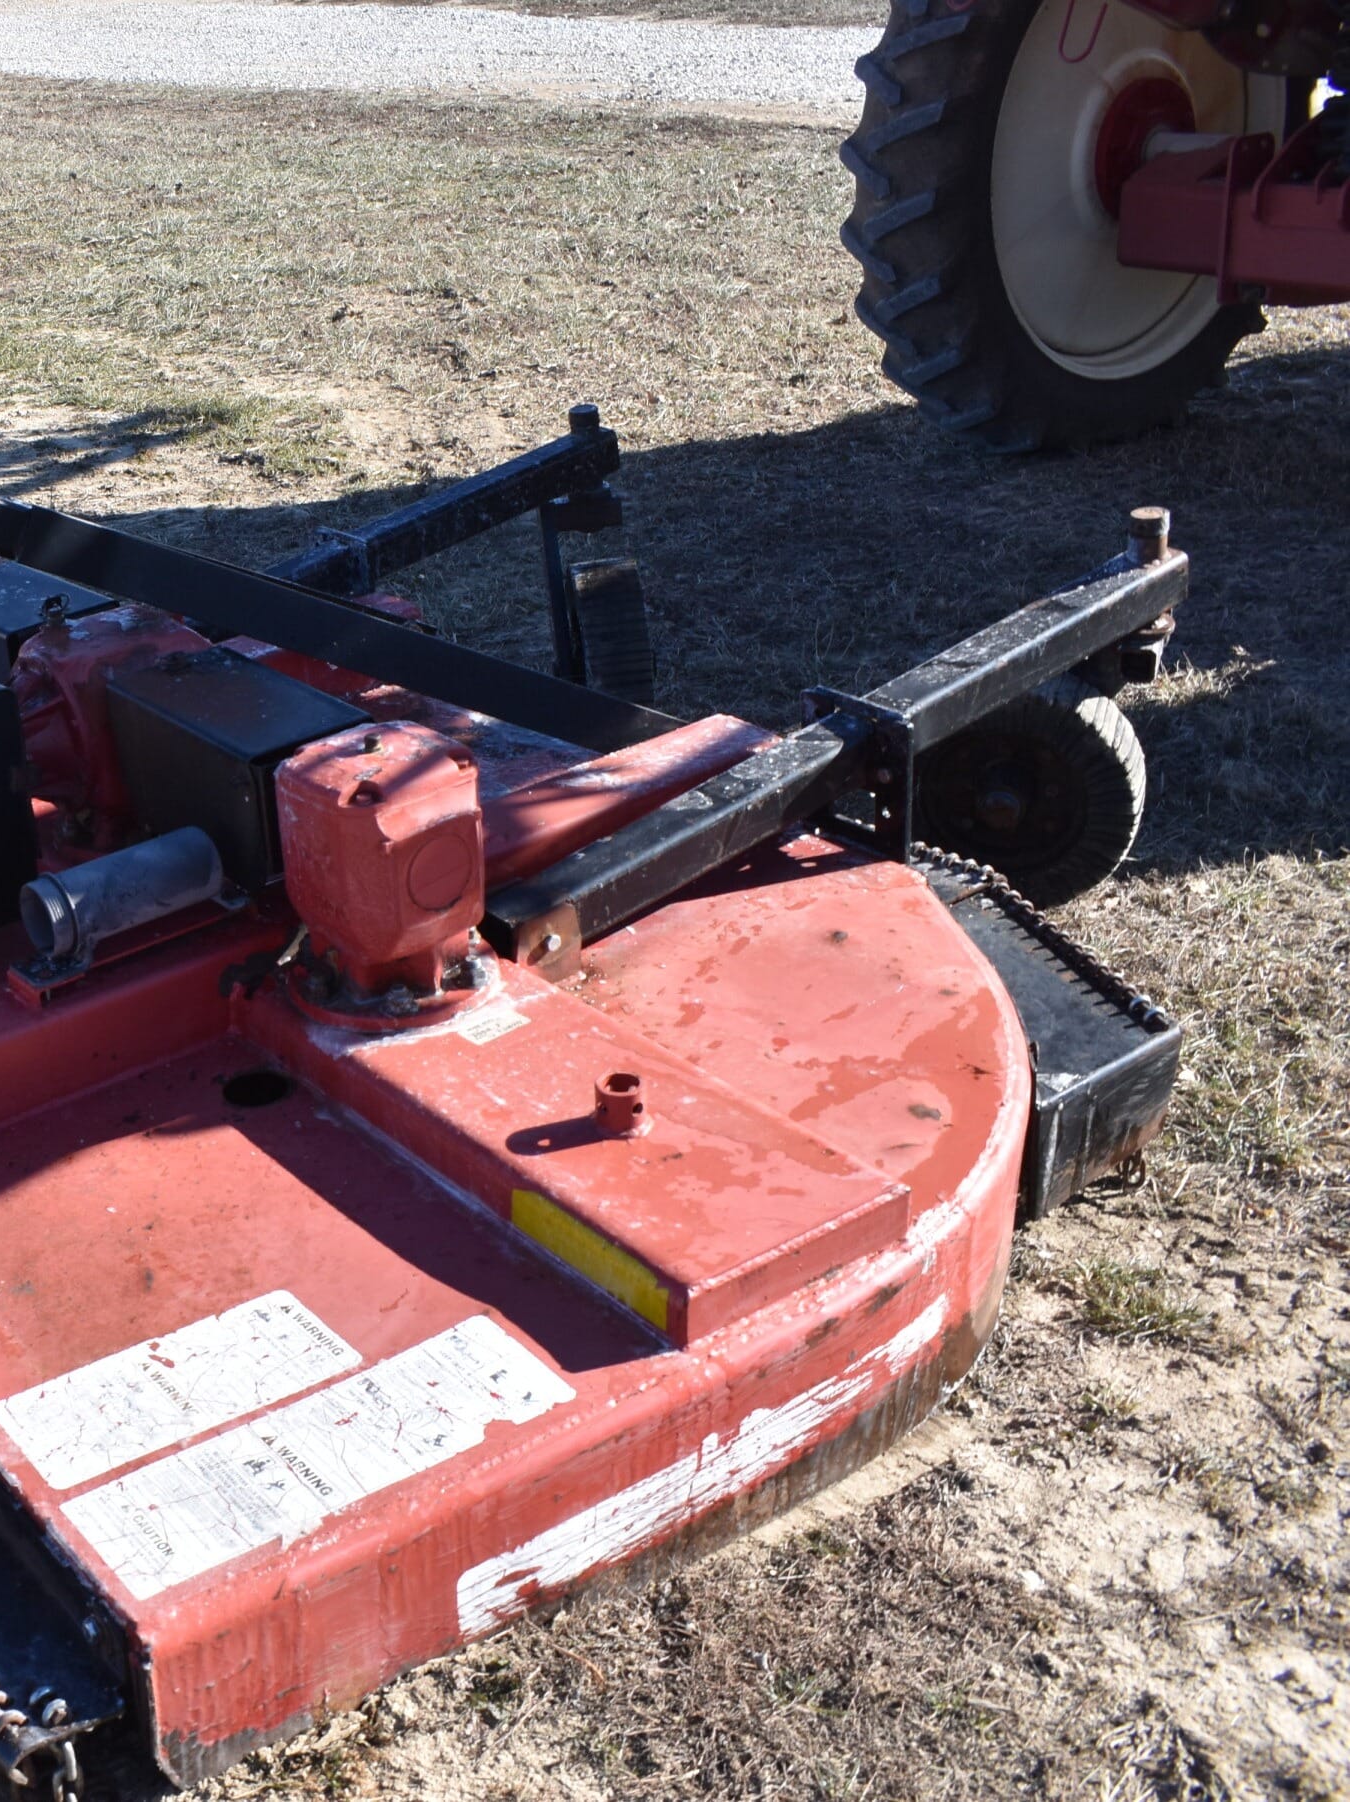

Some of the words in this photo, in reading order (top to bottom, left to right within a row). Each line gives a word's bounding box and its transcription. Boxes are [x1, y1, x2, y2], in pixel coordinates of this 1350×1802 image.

[292, 1313, 344, 1357] WARNING
[277, 1445, 334, 1497] WARNING
[132, 1513, 175, 1557] CAUTION
